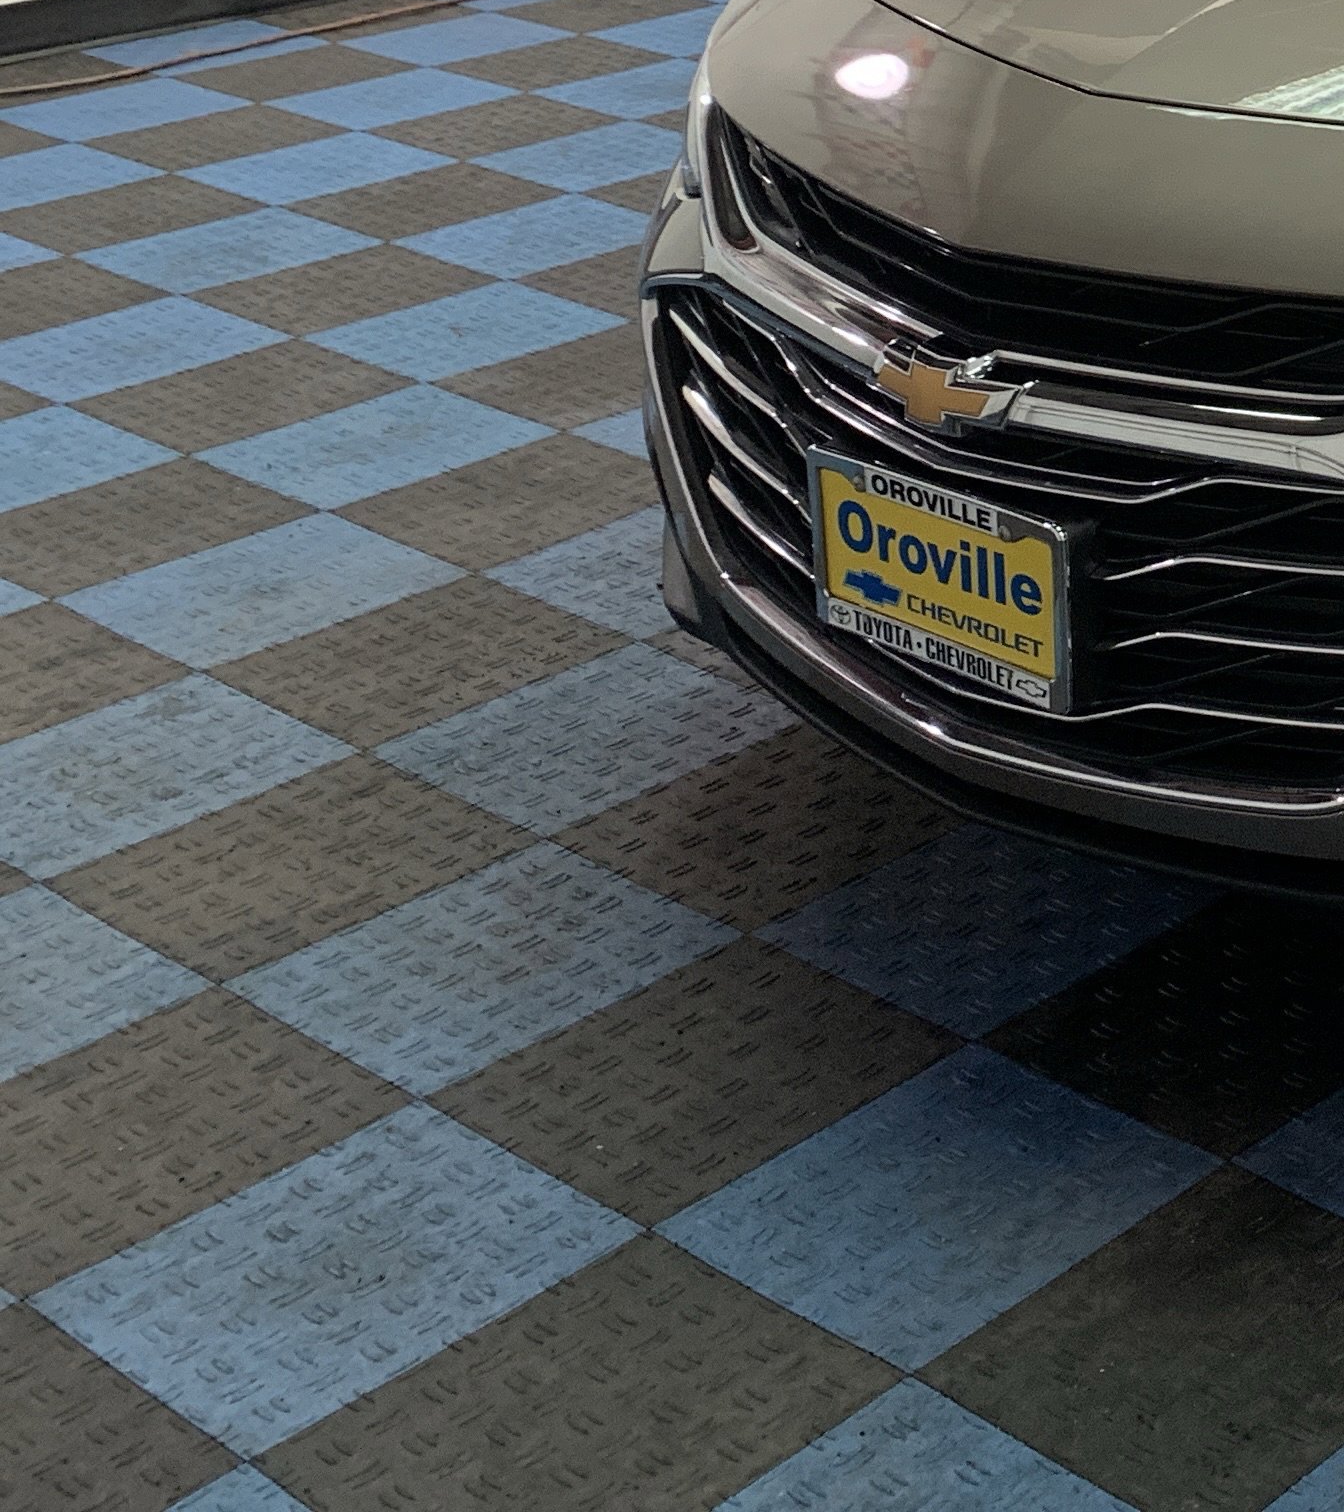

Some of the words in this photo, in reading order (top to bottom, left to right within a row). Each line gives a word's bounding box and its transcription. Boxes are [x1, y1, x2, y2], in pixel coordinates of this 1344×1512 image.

[870, 473, 993, 532] OROVILLE
[837, 499, 1043, 616] Oroville
[851, 609, 913, 651] TOYOTA
[925, 636, 1016, 691] CHEVROLET
[906, 592, 1045, 659] CHEVROLET
